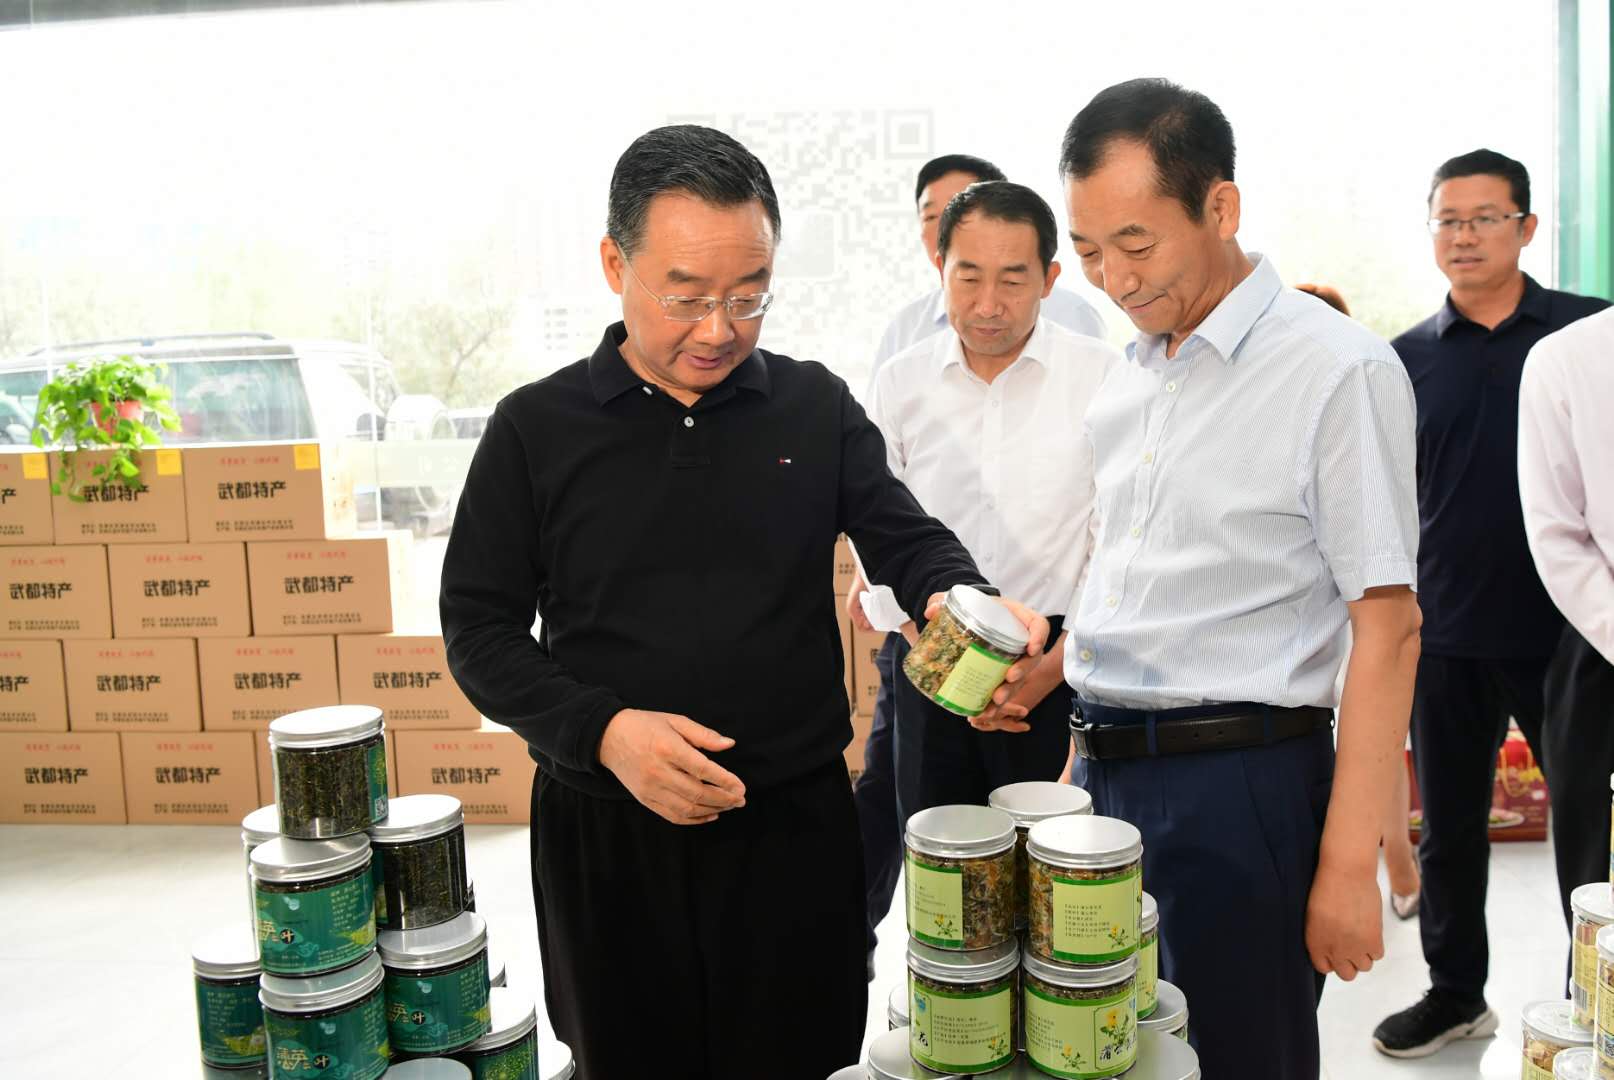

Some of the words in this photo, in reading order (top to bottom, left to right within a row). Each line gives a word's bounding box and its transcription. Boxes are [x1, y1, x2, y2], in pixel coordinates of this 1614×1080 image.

[84, 484, 150, 503] 武都特产
[218, 480, 286, 500] 武都特产
[9, 582, 72, 600] 武都特产
[144, 579, 210, 597] 武都特产
[285, 575, 354, 594] 武都特产
[96, 675, 161, 692] 武都特产
[234, 672, 301, 690] 武都特产
[372, 671, 444, 690] 武都特产
[24, 766, 89, 786] 武都特产
[155, 766, 222, 784] 武都特产
[432, 767, 500, 784] 武都特产
